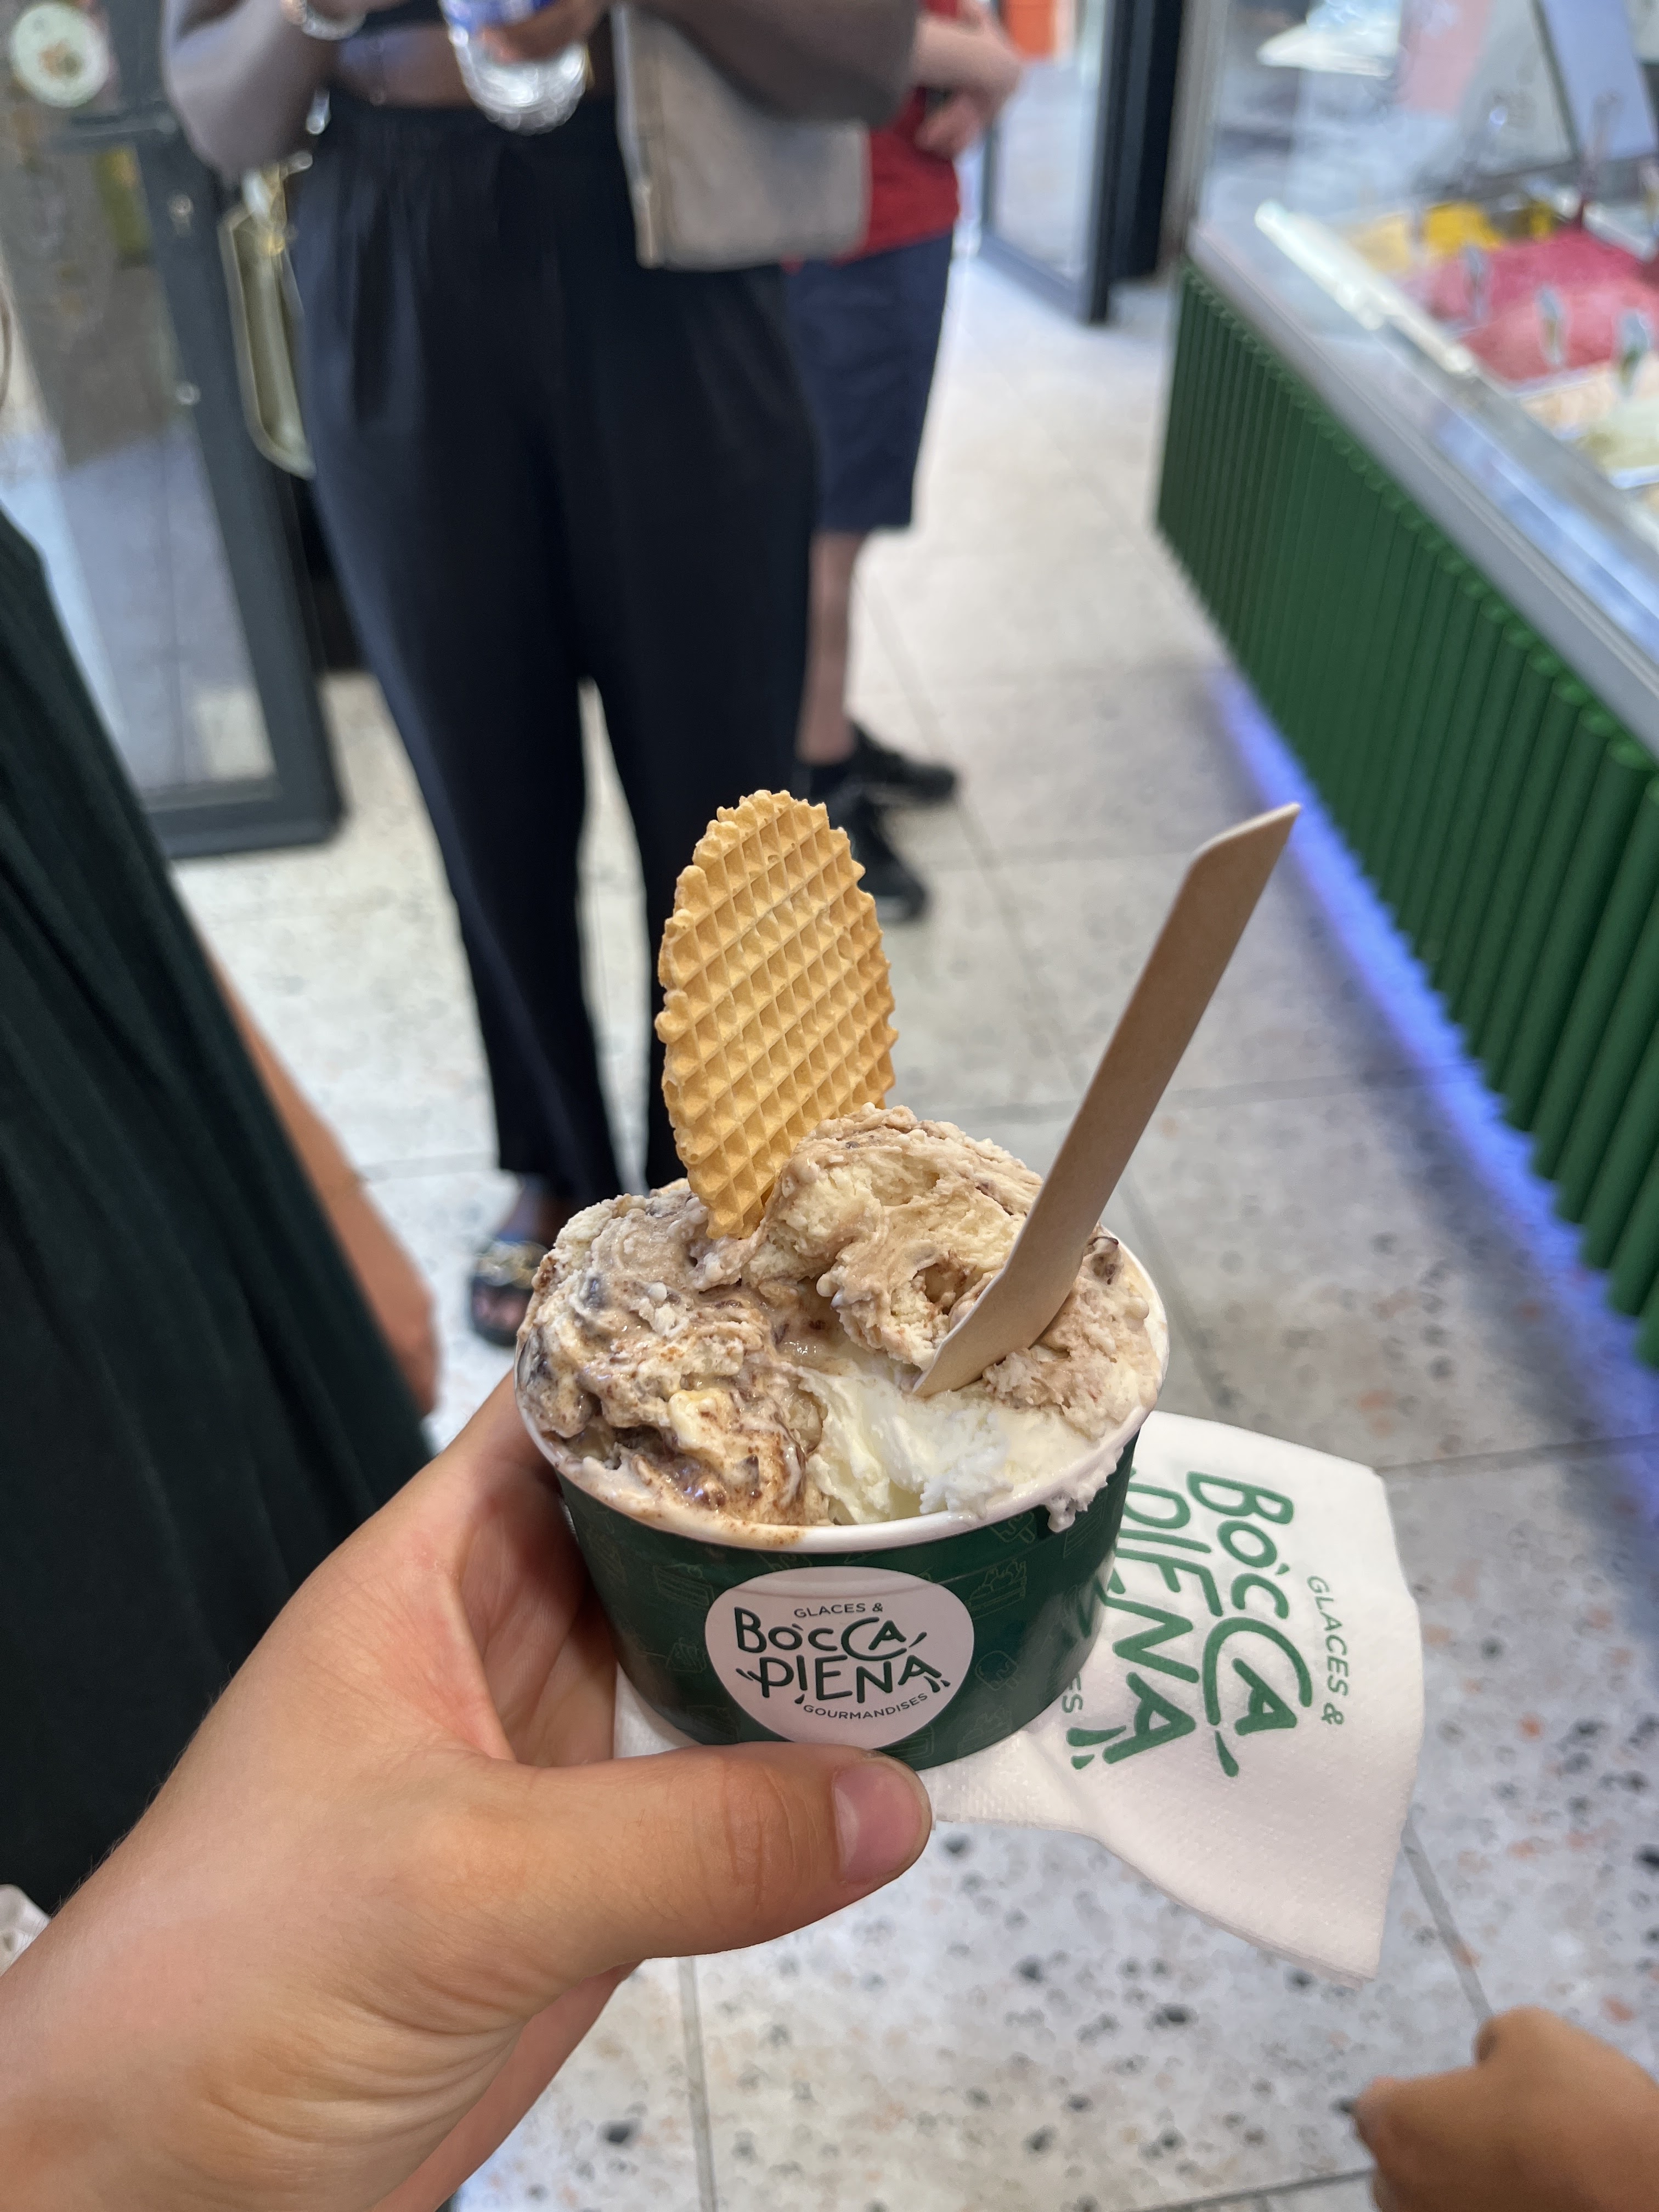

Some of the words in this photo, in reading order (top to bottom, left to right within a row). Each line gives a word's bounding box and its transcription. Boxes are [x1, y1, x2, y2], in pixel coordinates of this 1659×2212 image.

[794, 1602, 866, 1618] GLACES
[872, 1602, 883, 1612] &
[1186, 1471, 1313, 1736] BOCCA
[734, 1606, 907, 1661] BOCCA
[1306, 1575, 1349, 1696] GLACES
[748, 1655, 942, 1704] PIENA
[803, 1693, 928, 1719] GOURMANDISES
[1321, 1702, 1344, 1725] &
